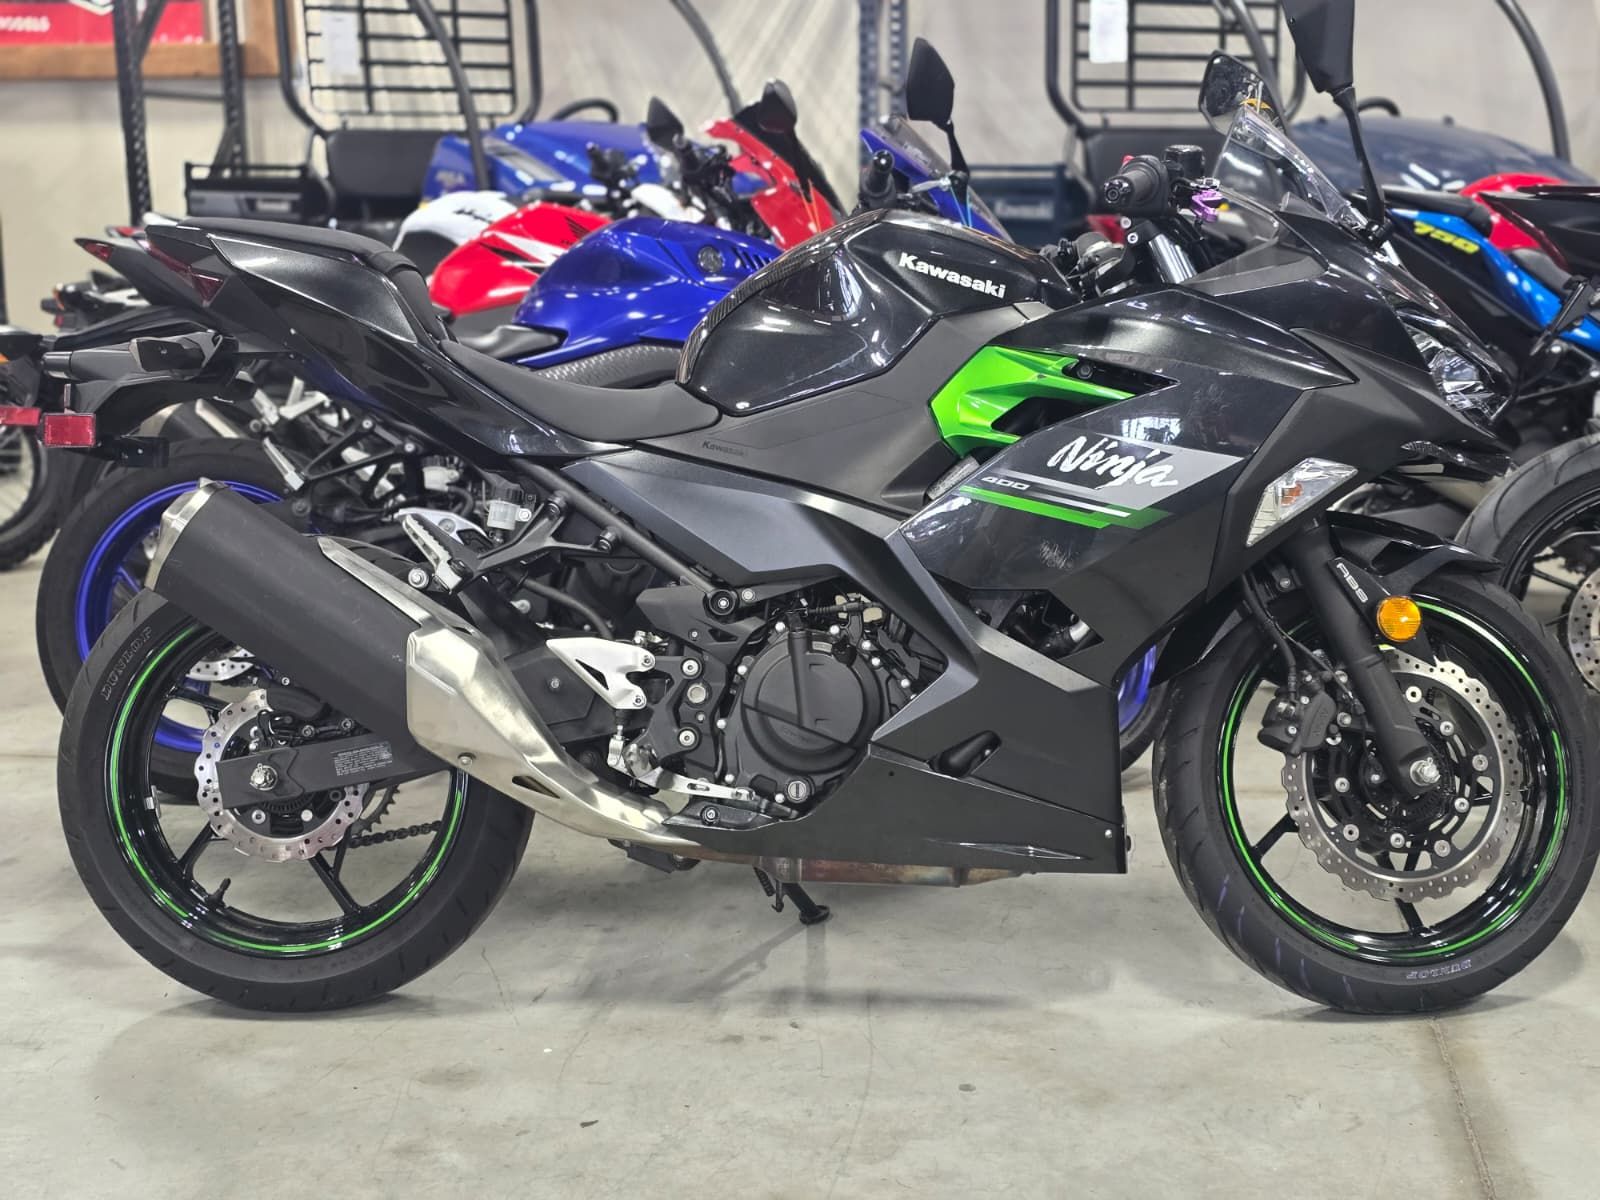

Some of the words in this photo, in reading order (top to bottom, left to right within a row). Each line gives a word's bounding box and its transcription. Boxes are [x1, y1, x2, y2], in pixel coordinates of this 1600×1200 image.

[1413, 220, 1479, 254] 750
[898, 252, 1006, 299] Kawasaki
[1046, 435, 1179, 490] Ninja
[981, 476, 1031, 491] 400
[1336, 562, 1369, 603] ABS
[100, 626, 152, 702] DUNLOP
[1406, 959, 1472, 980] DUNLOP
